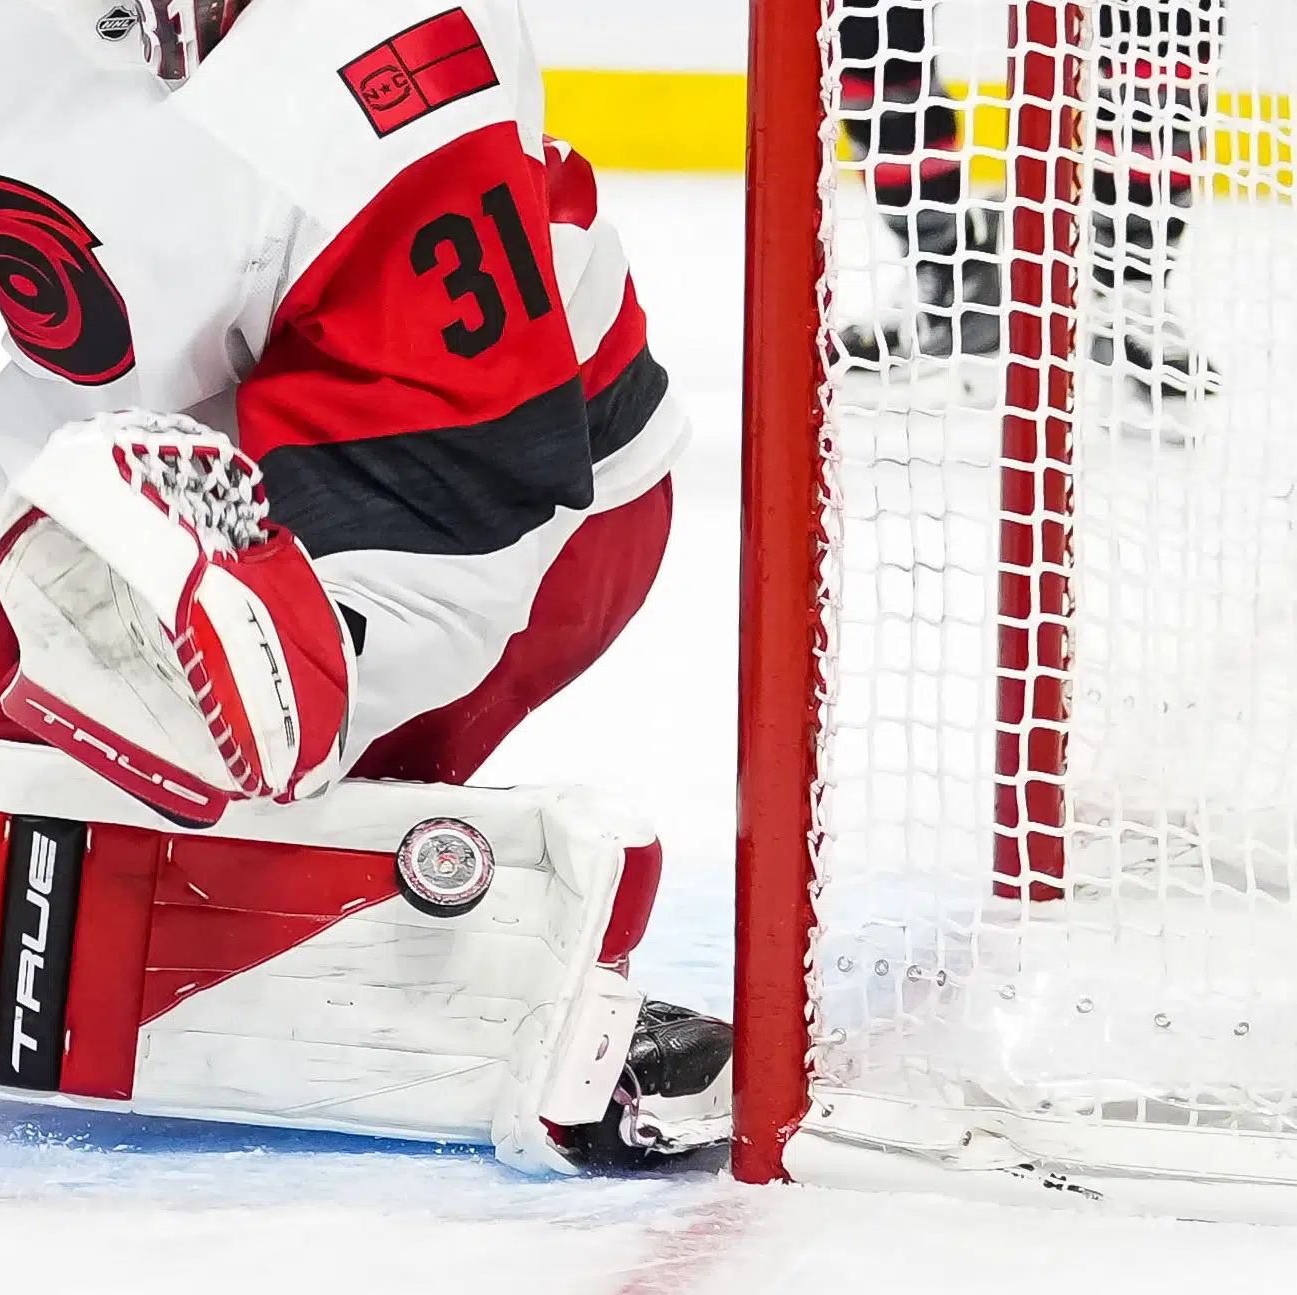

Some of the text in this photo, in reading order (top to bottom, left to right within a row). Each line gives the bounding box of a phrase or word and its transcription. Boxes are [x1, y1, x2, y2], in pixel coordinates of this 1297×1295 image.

[410, 181, 554, 360] 31
[25, 697, 209, 806] TRUE
[246, 599, 295, 749] TRUE
[11, 830, 58, 1074] TRUE
